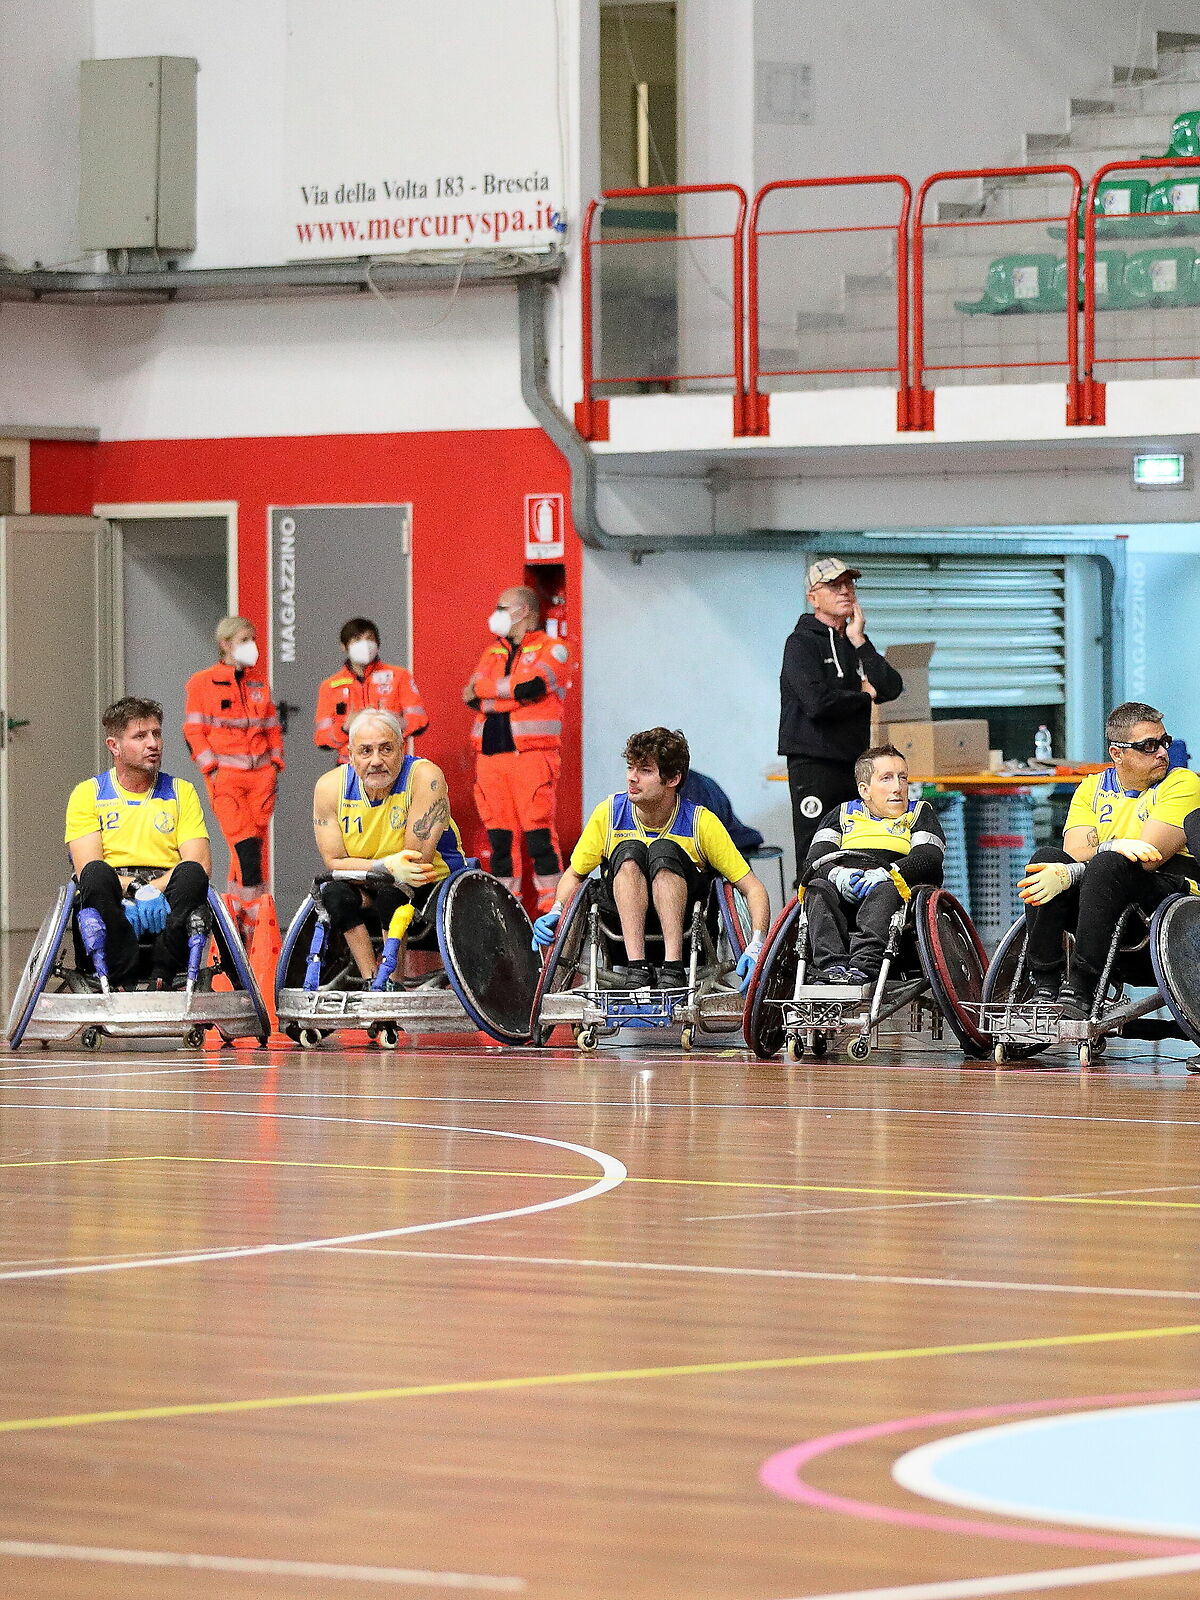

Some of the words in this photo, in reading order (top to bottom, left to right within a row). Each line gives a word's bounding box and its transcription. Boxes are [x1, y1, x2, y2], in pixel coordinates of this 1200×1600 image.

[301, 185, 329, 205] Via
[335, 182, 376, 204] della
[383, 179, 428, 200] Volta
[436, 175, 464, 198] 183
[483, 171, 550, 195] Brescia
[296, 200, 554, 243] www.mercuryspa.it
[279, 516, 296, 663] MAGAZZINO
[341, 815, 363, 834] 11
[1100, 804, 1113, 823] 2
